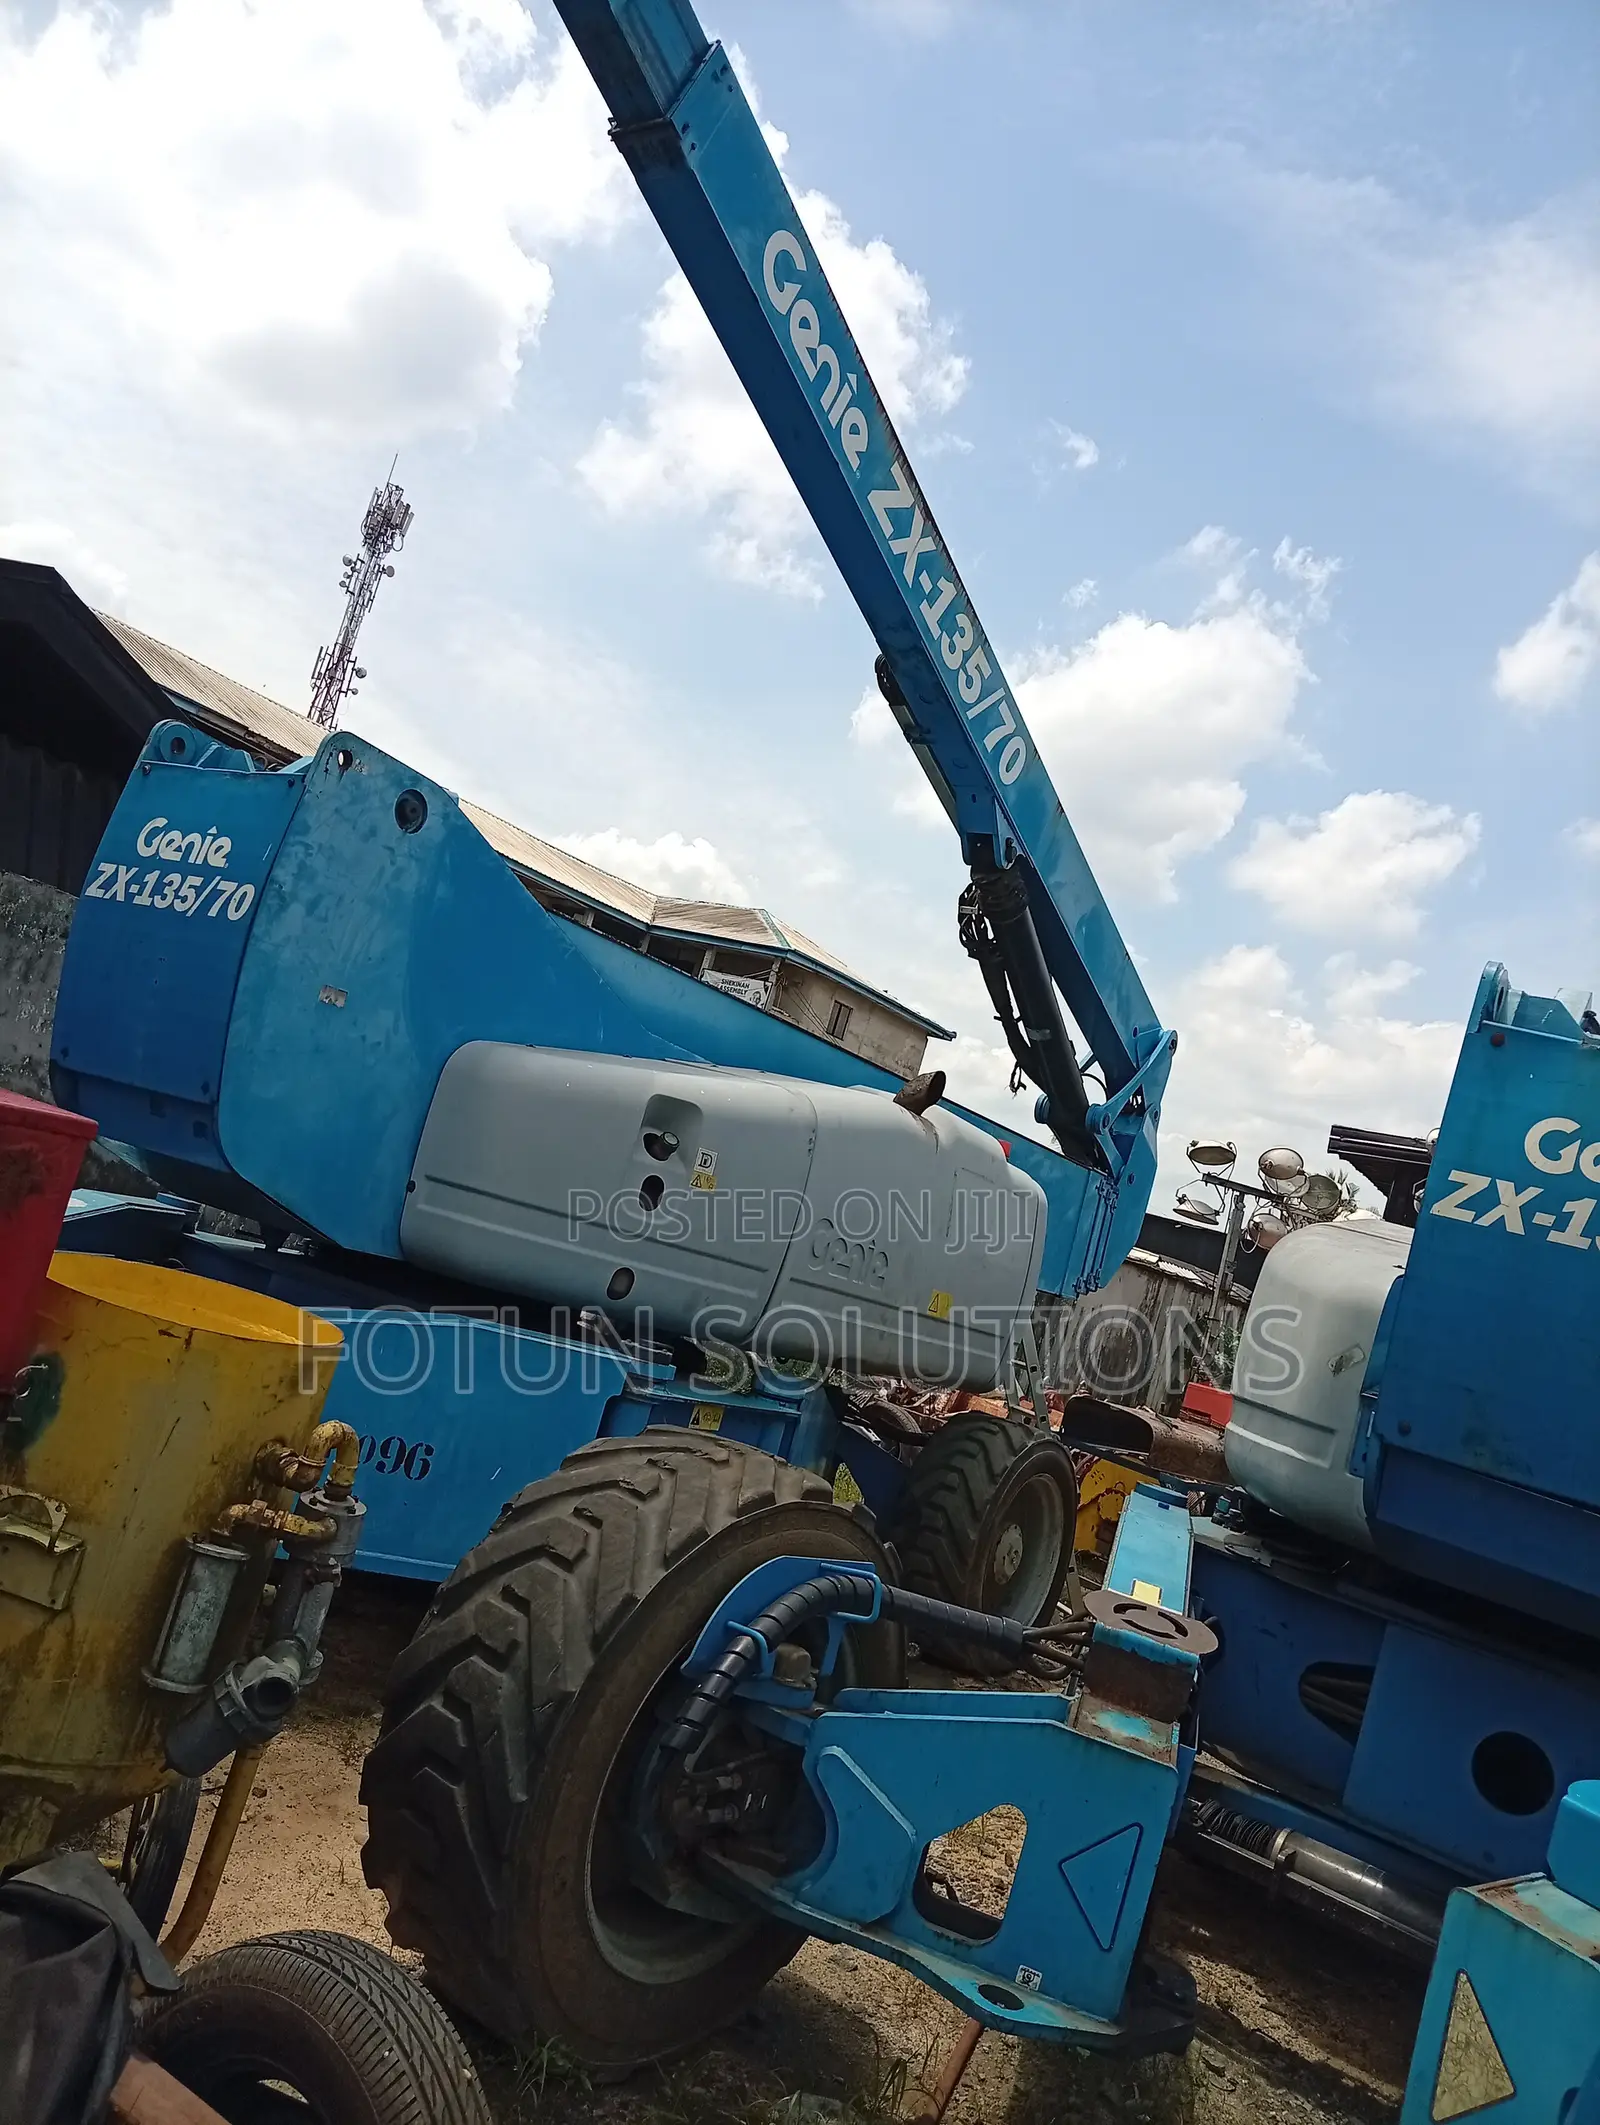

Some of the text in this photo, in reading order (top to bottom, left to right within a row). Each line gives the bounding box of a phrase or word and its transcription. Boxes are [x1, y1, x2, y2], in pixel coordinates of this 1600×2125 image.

[763, 230, 1026, 785] Genie ZX-135/70
[137, 817, 232, 868] Genie
[85, 862, 255, 921] ZX-135/70
[1430, 1169, 1600, 1250] ZX-1
